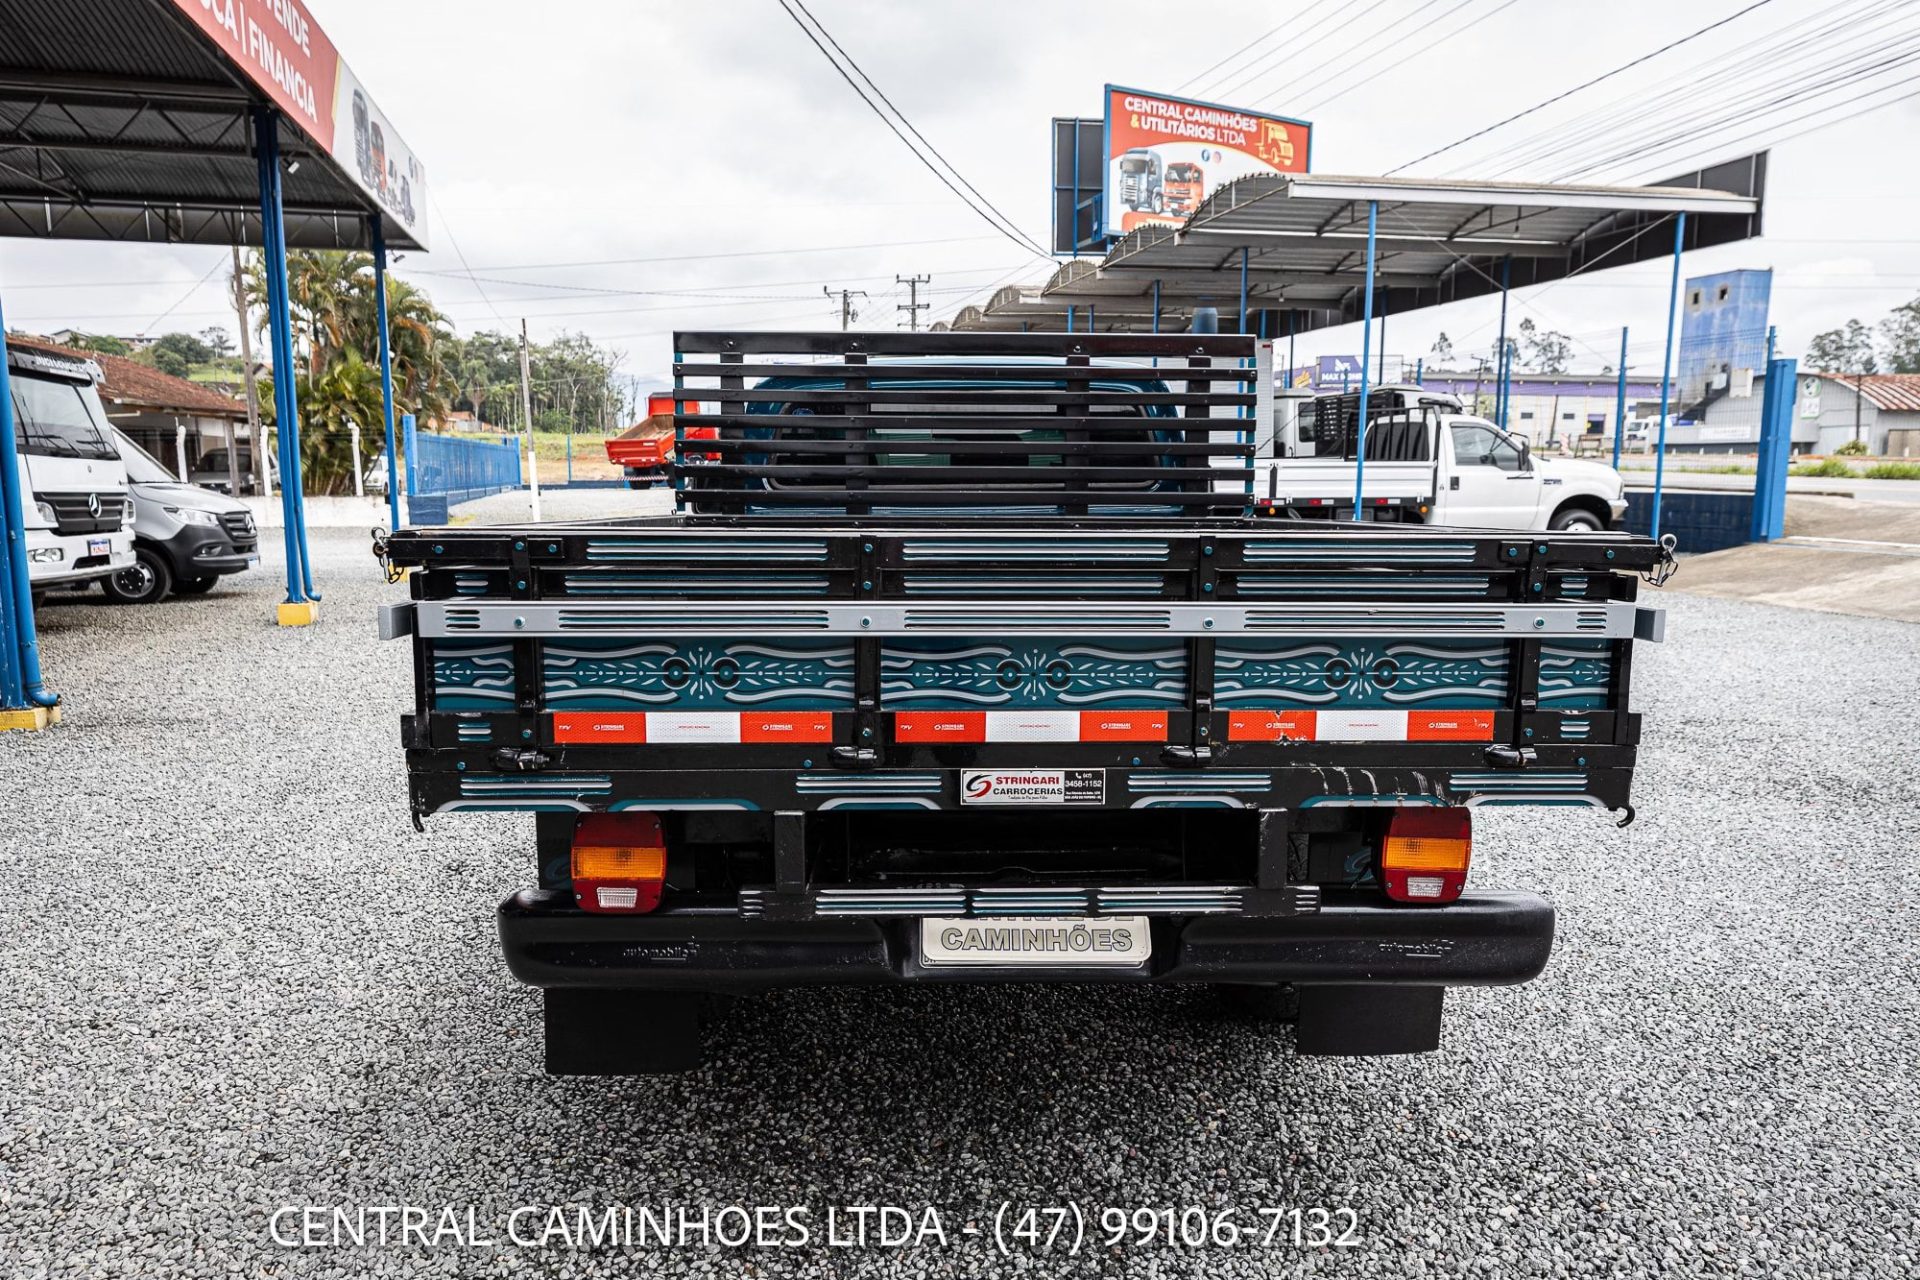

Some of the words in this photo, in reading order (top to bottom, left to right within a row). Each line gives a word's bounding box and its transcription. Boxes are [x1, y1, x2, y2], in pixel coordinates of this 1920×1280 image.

[248, 16, 317, 124] FINANCIA
[1124, 96, 1183, 119] CENTRAL
[1184, 107, 1258, 133] CAMINHÕES
[1130, 113, 1140, 129] &
[1141, 115, 1216, 141] UTILITÁRIOS
[1216, 129, 1247, 147] LTDA
[996, 776, 1060, 785] STRINGARI
[941, 924, 1133, 952] CAMINHÕES
